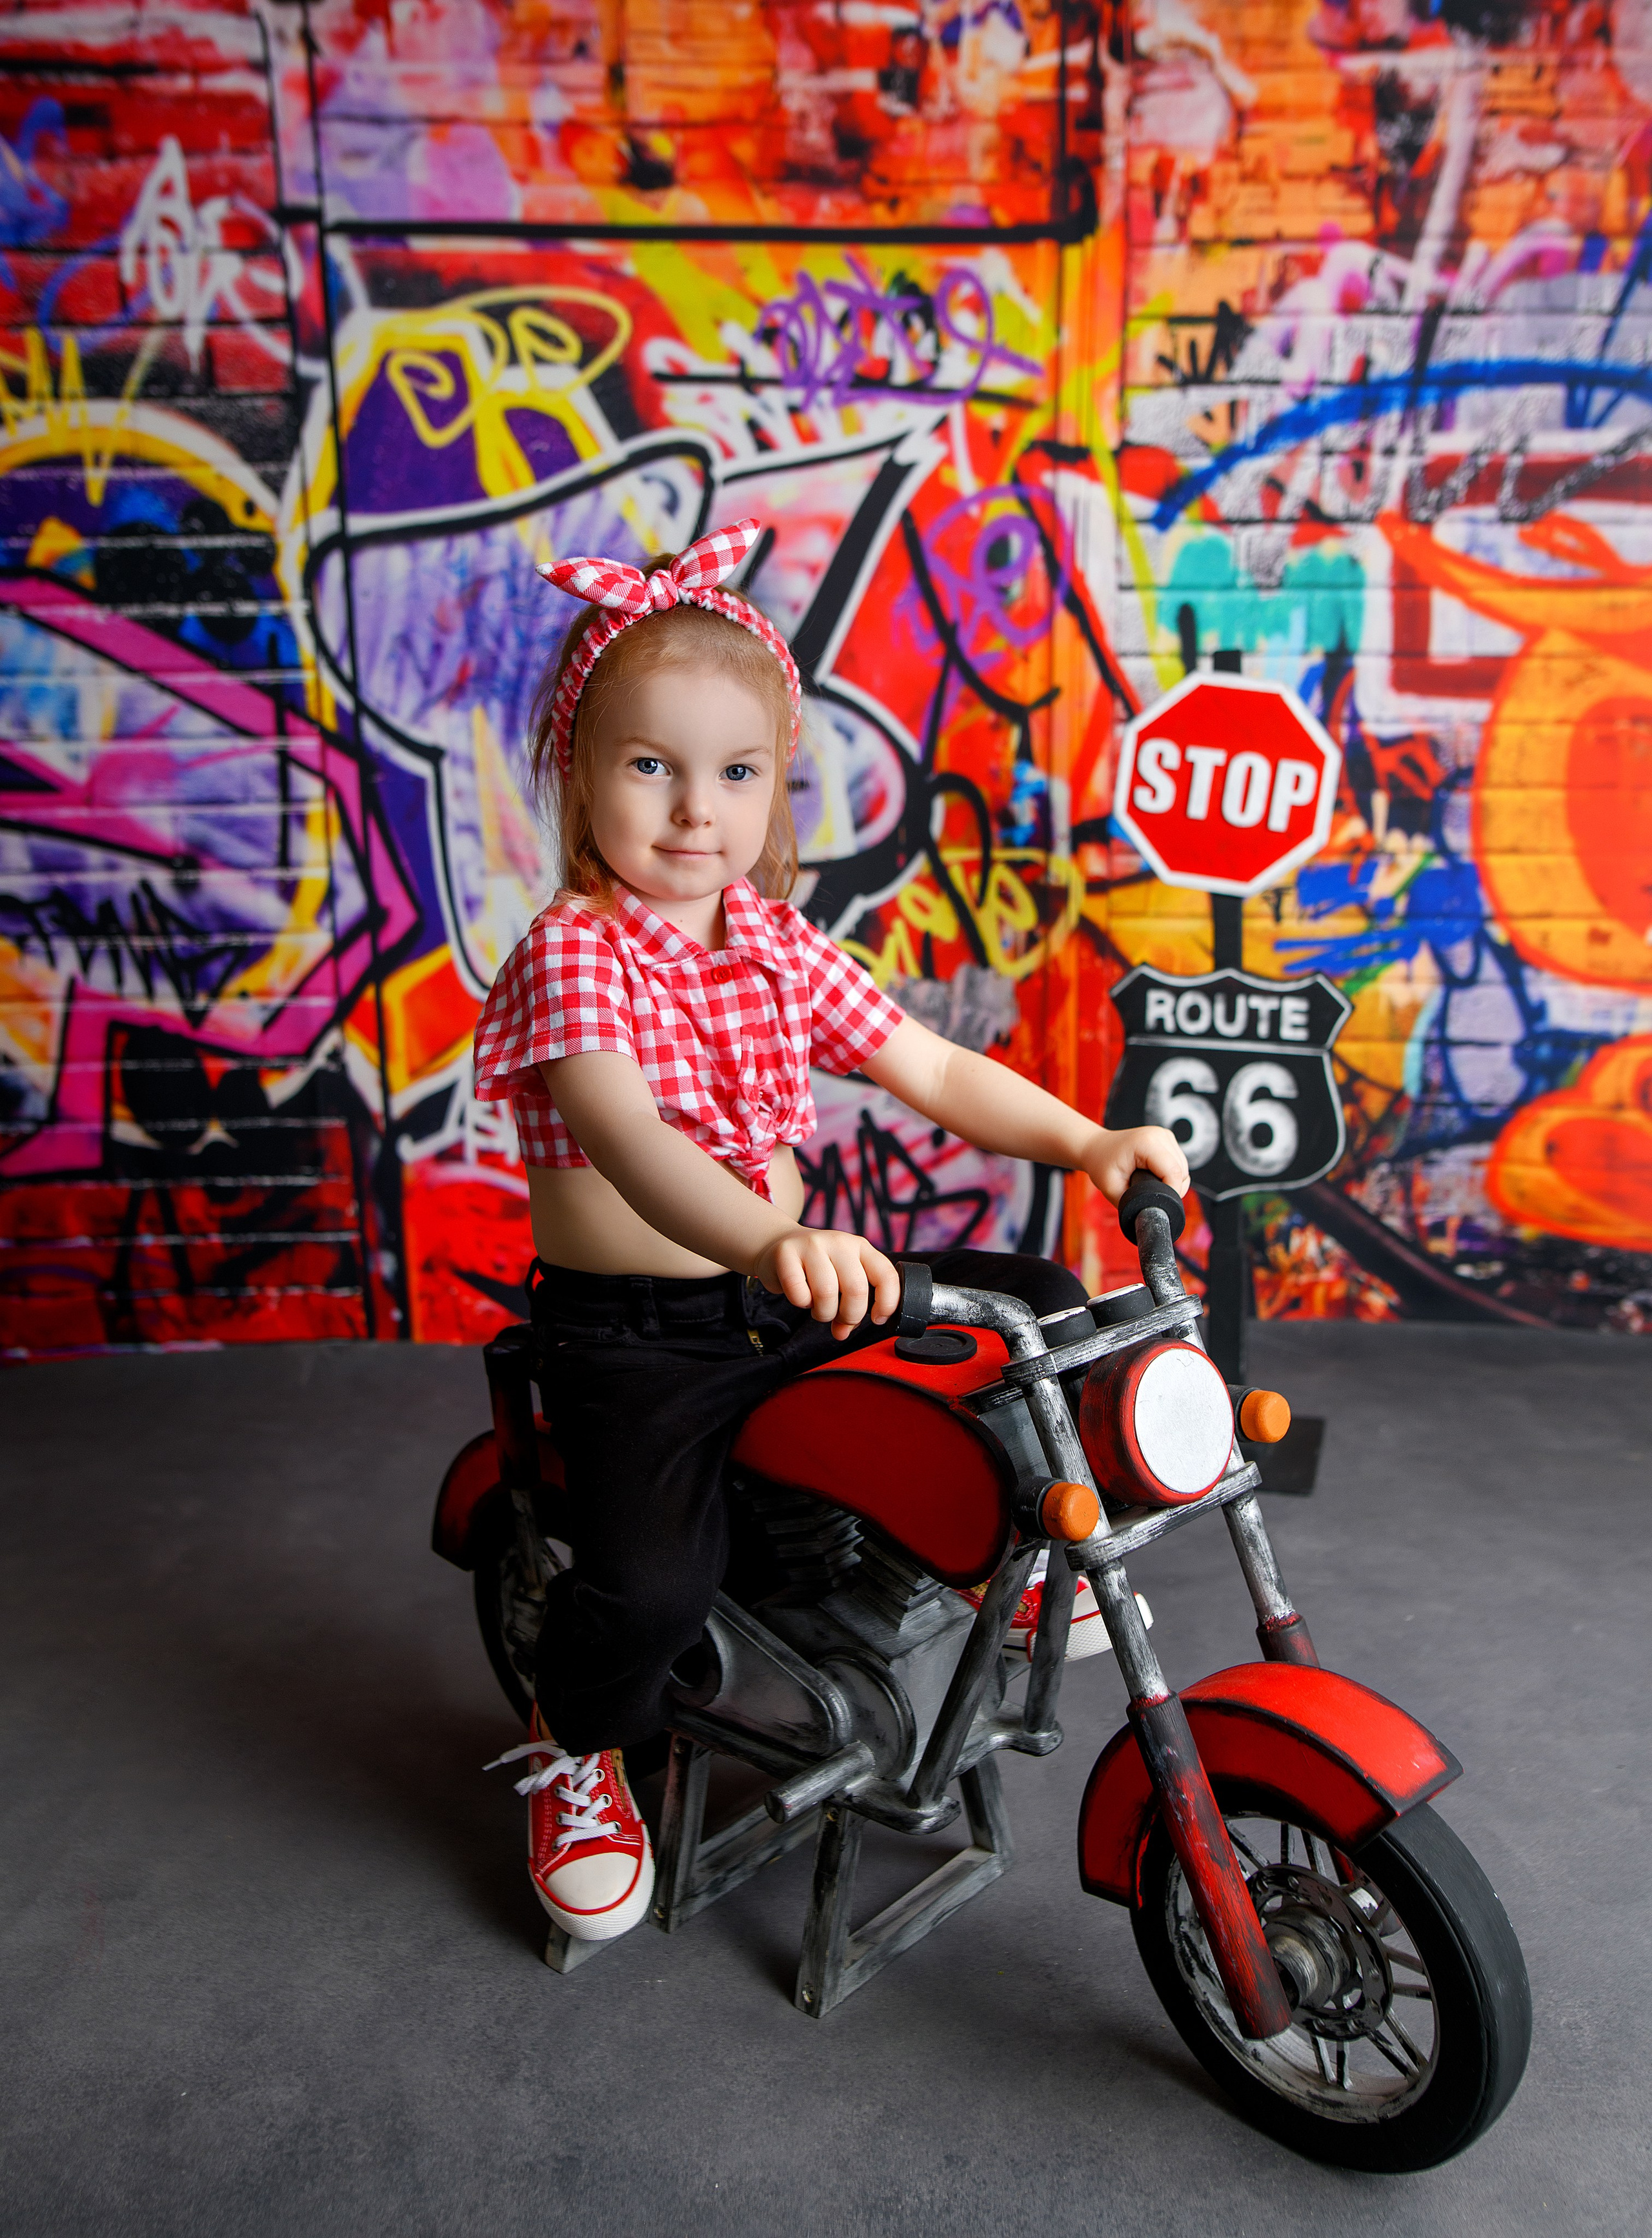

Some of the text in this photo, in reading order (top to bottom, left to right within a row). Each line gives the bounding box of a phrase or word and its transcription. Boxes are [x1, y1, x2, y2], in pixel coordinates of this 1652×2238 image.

[1133, 738, 1317, 832] STOP
[1146, 989, 1309, 1041] ROUTE
[1146, 1056, 1298, 1176] 66
